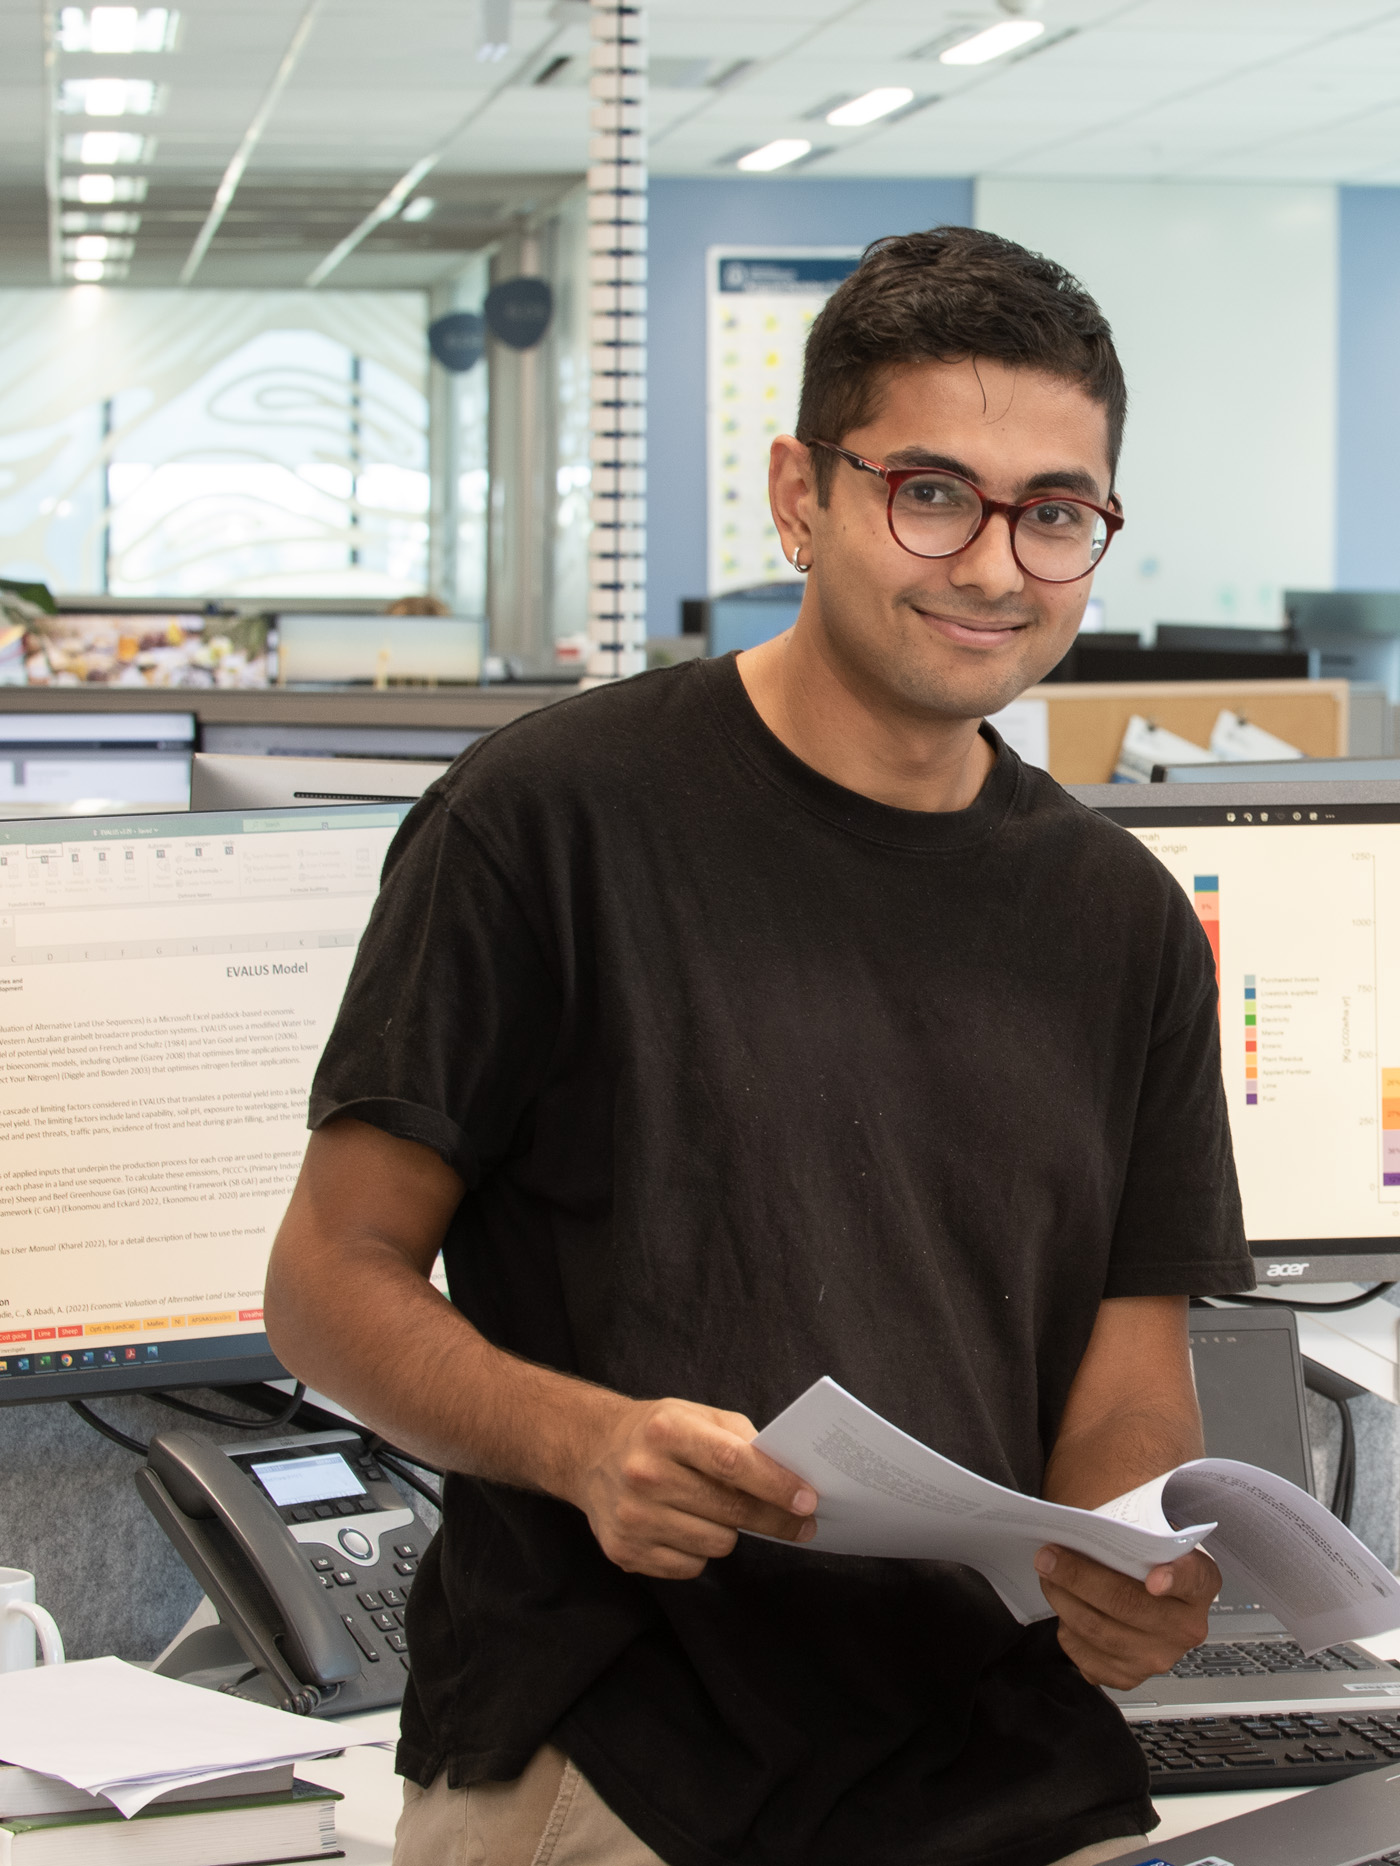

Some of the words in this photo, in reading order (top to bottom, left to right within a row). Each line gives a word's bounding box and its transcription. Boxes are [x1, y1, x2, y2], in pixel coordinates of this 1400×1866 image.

[1161, 844, 1188, 854] origin
[226, 963, 268, 977] EVALUS
[272, 961, 307, 974] Model
[34, 1021, 72, 1030] Alternative
[158, 1013, 191, 1023] Microsoft
[211, 1009, 261, 1021] paddock-based
[263, 1007, 296, 1016] economic
[26, 1034, 61, 1043] Australian
[62, 1031, 93, 1042] grainbelt
[94, 1030, 129, 1039] broadacre
[130, 1027, 168, 1038] production
[200, 1023, 227, 1032] EVALUS
[250, 1019, 279, 1029] modified
[5, 1060, 49, 1070] bioeconomic
[80, 1056, 110, 1065] including
[201, 1048, 234, 1058] optimises
[250, 1044, 290, 1055] applications
[17, 1047, 48, 1058] potential
[99, 1043, 122, 1052] French
[138, 1040, 162, 1049] Schultz
[100, 1068, 128, 1076] Bowden
[166, 1063, 199, 1074] optimises
[200, 1062, 229, 1071] nitrogen
[230, 1059, 257, 1068] fertiliser
[6, 1106, 30, 1115] cascade
[40, 1104, 65, 1113] limiting
[66, 1102, 90, 1110] factors
[92, 1099, 130, 1109] considered
[139, 1096, 165, 1105] EVALUS
[182, 1093, 215, 1103] translates
[222, 1090, 251, 1102] potential
[289, 1087, 306, 1096] likely
[47, 1115, 72, 1124] limiting
[74, 1114, 98, 1122] factors
[99, 1111, 123, 1120] include
[203, 1105, 234, 1114] exposure
[70, 1126, 90, 1135] traffic
[111, 1123, 144, 1132] incidence
[202, 1117, 224, 1126] during
[12, 1168, 37, 1179] applied
[38, 1167, 60, 1177] inputs
[76, 1163, 108, 1173] underpin
[122, 1160, 159, 1171] production
[160, 1159, 187, 1168] process
[272, 1148, 302, 1160] generate
[134, 1171, 164, 1181] calculate
[221, 1165, 248, 1174] PICCC's
[69, 1189, 110, 1198] Greenhouse
[149, 1182, 187, 1192] Accounting
[188, 1179, 227, 1189] Framework
[116, 1198, 139, 1207] Eckard
[162, 1195, 198, 1203] Ekonomou
[251, 1186, 285, 1197] integrated
[28, 1242, 56, 1252] Manual
[125, 1235, 144, 1244] detail
[146, 1233, 183, 1243] description
[1266, 1263, 1310, 1276] acer
[89, 1300, 122, 1310] Economic
[124, 1297, 157, 1307] Valuation
[167, 1293, 204, 1303] Alternative
[62, 1328, 79, 1336] Sheep
[366, 1594, 373, 1602] 1
[388, 1590, 396, 1599] 2
